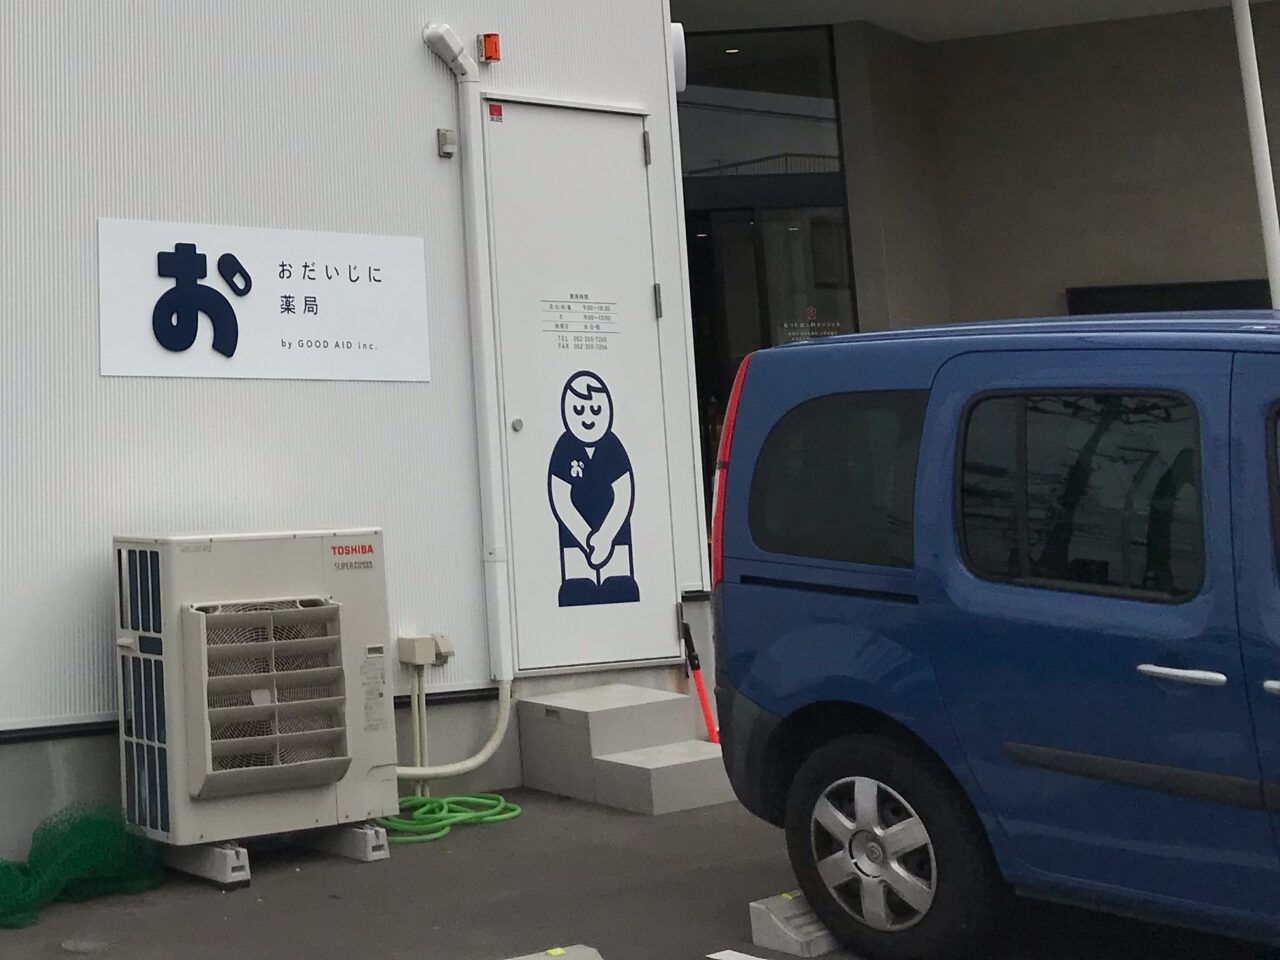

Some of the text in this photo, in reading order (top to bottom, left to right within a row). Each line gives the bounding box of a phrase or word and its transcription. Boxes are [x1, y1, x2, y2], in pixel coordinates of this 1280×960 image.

[277, 260, 383, 284] おだいじに
[151, 242, 253, 358] お
[279, 294, 320, 316] 薬局
[280, 338, 292, 349] by
[297, 339, 329, 349] GOOD
[334, 340, 353, 350] AID
[331, 544, 374, 556] TOSHIBA
